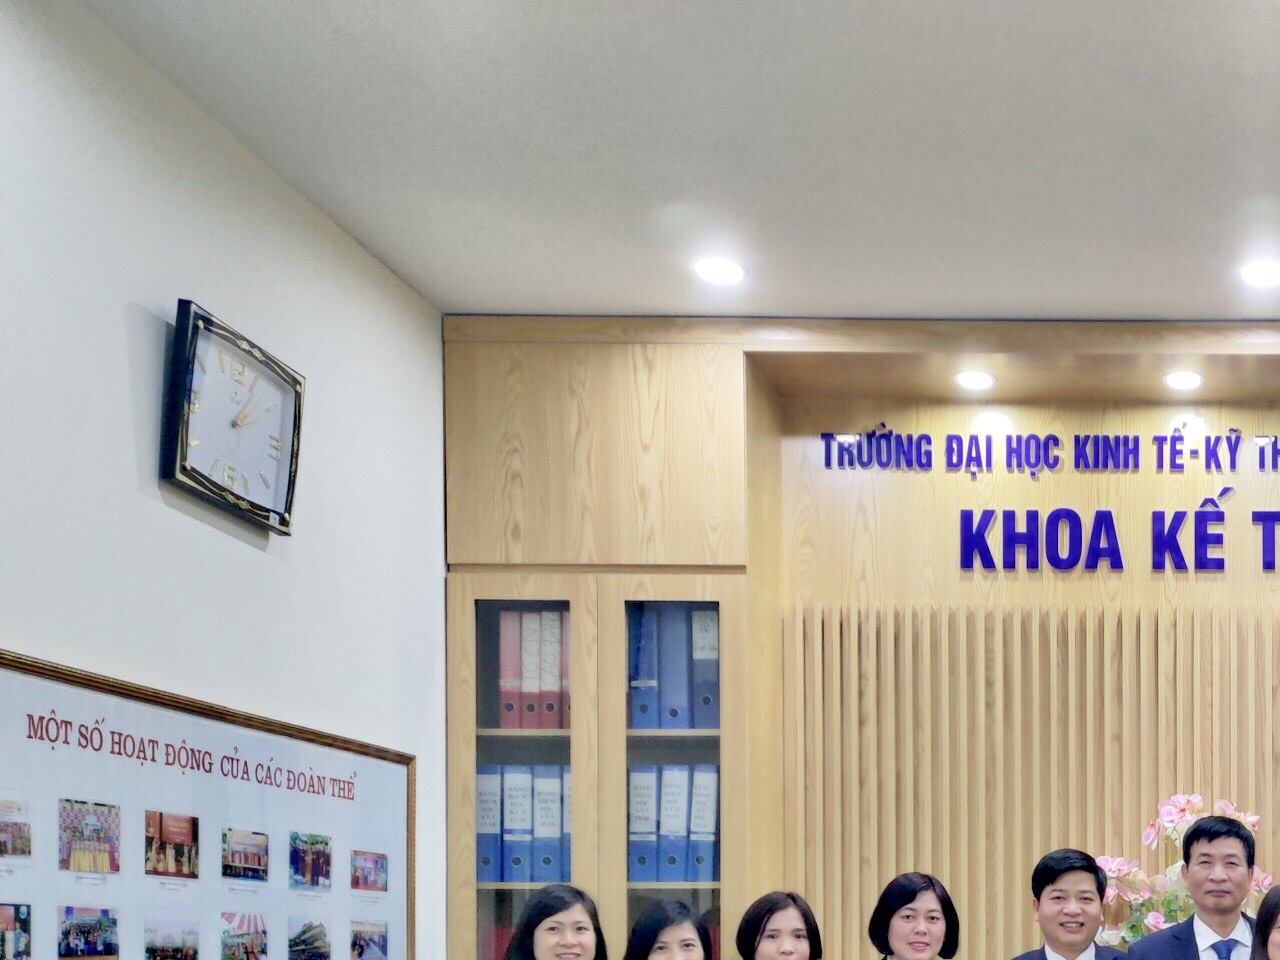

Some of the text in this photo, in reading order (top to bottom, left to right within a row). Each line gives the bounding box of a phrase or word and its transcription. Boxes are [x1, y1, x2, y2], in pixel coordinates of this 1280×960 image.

[821, 422, 932, 470] TRƯỜNG
[945, 433, 993, 479] ĐẠI
[1006, 433, 1060, 479] HỌC
[1074, 434, 1140, 471] KINH
[959, 507, 1124, 571] KHOA
[1151, 486, 1234, 571] KẾ
[26, 708, 357, 801] MỘT SỐ HOẠT ĐỘNG CỦA CÁC ĐOÀN THỂ
